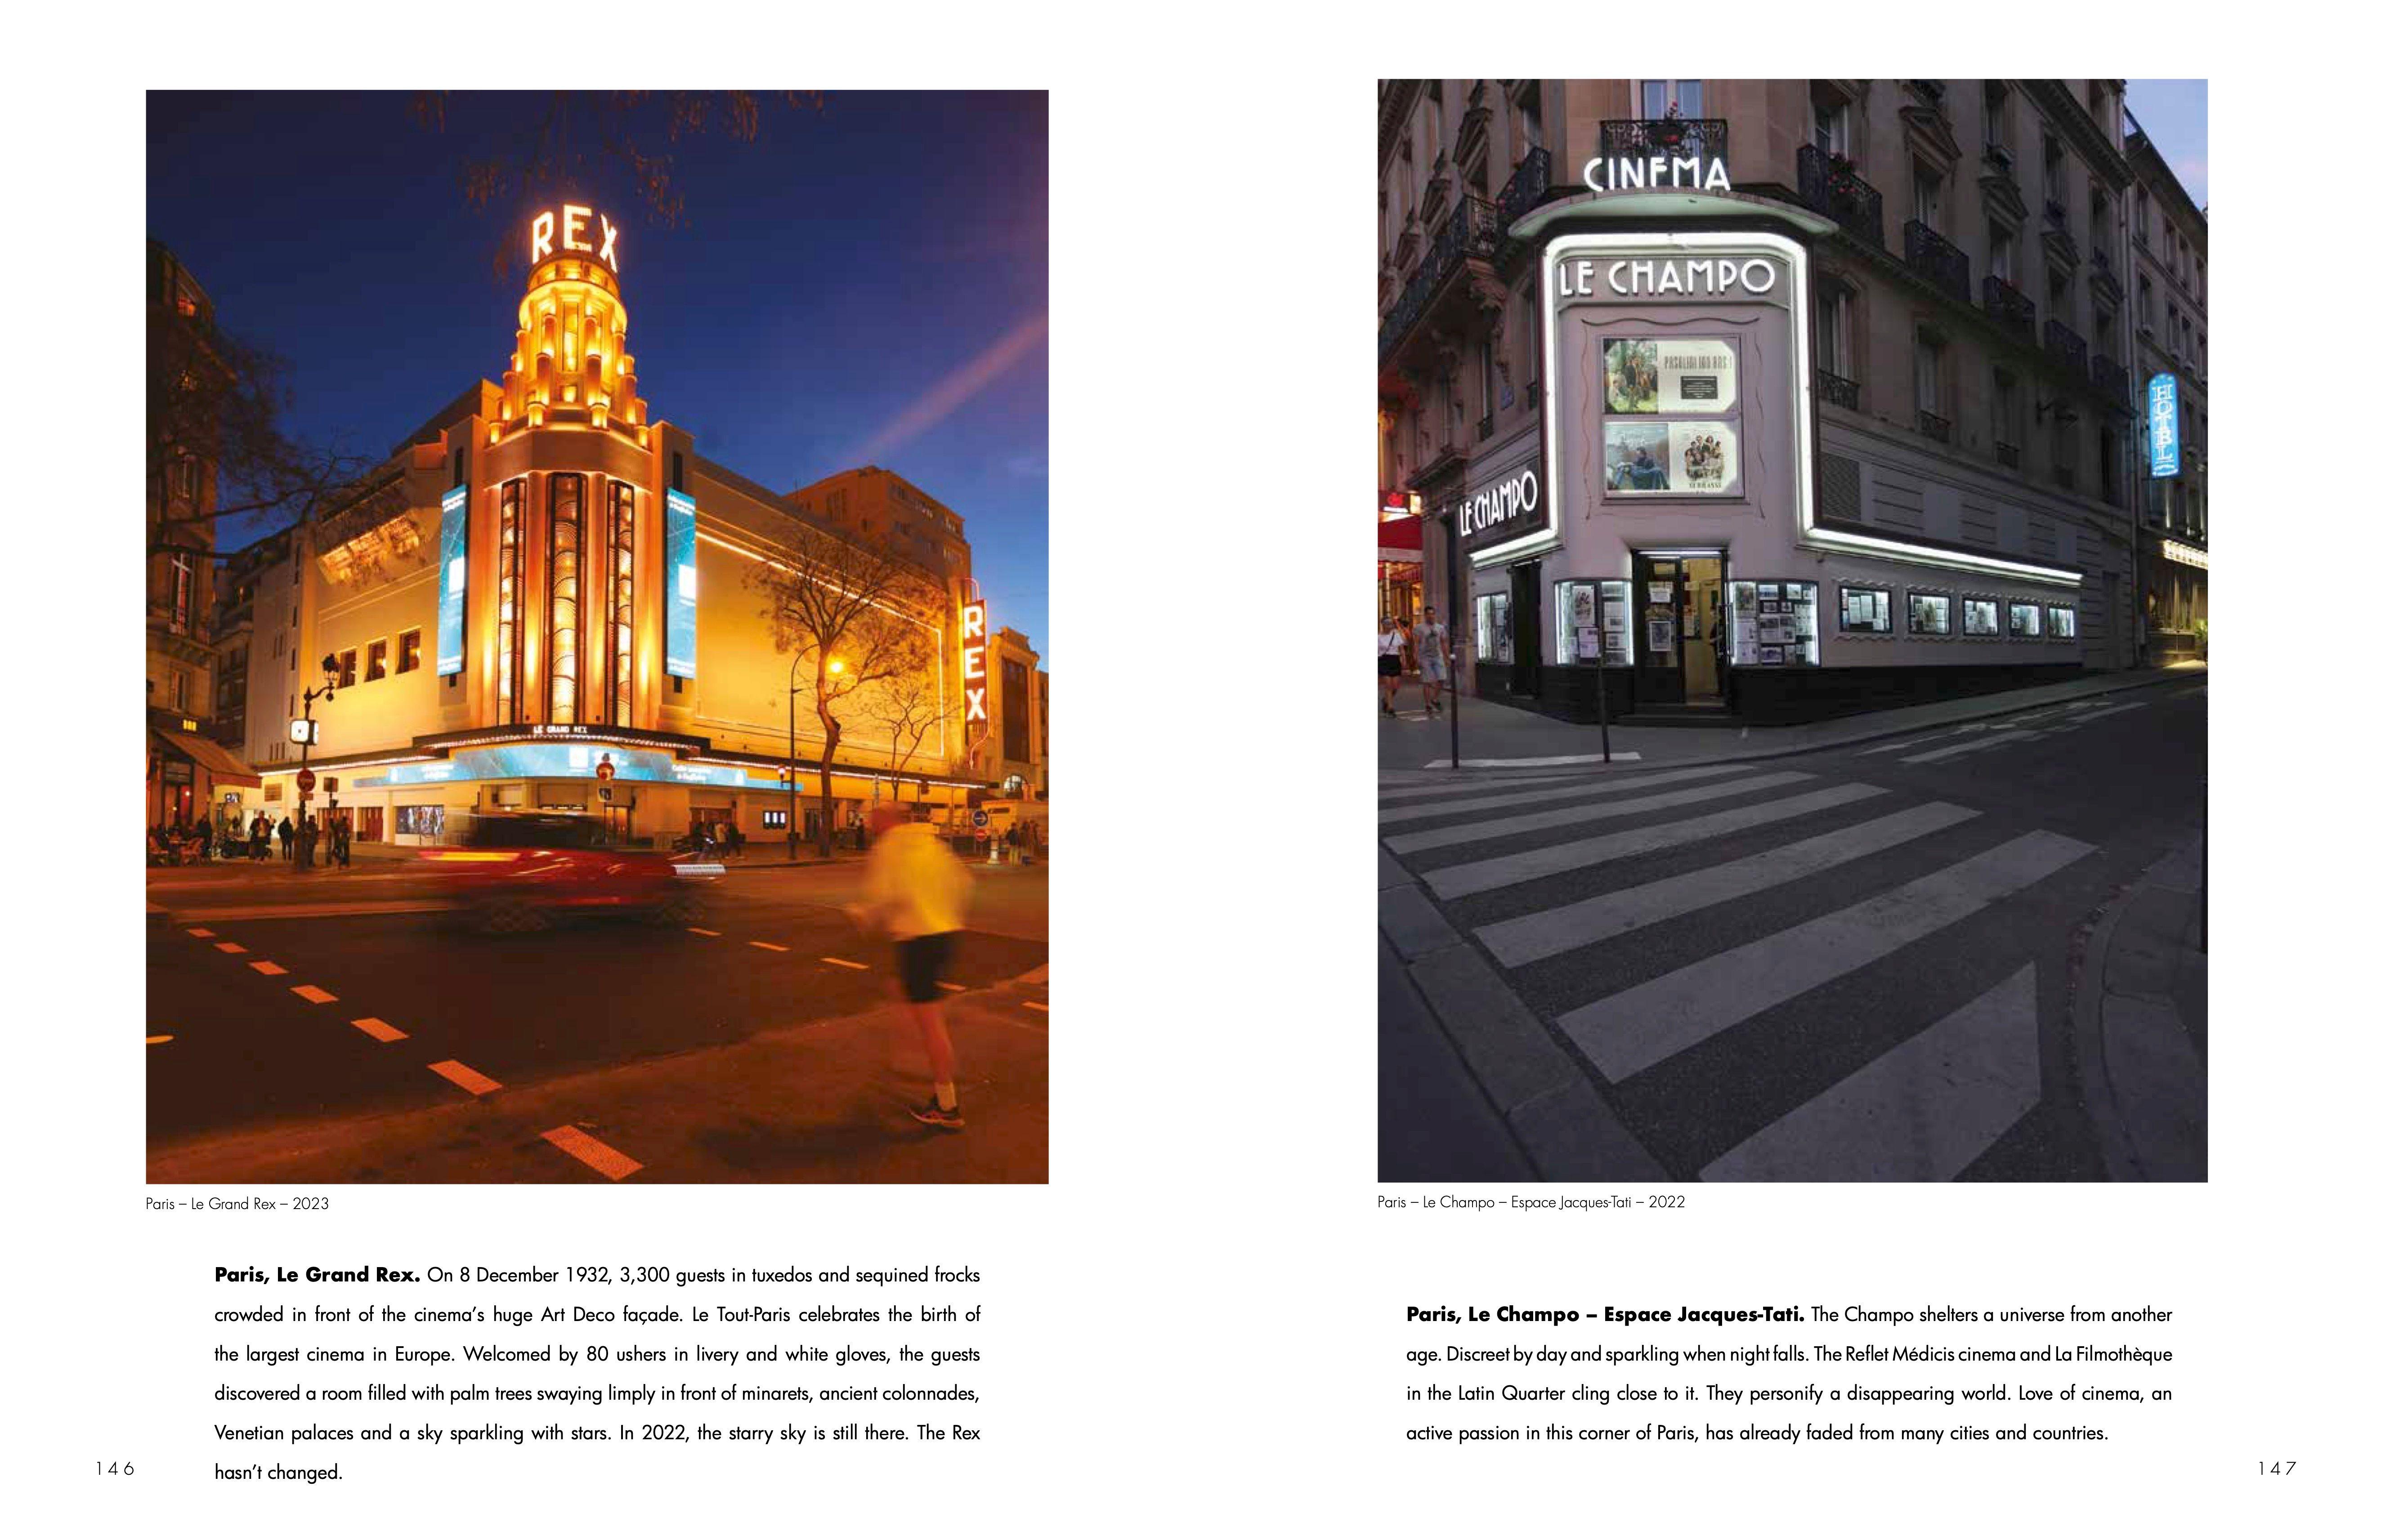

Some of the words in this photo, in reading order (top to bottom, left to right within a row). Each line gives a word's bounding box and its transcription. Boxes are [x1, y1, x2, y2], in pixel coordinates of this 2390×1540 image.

[532, 205, 618, 273] REX
[1560, 261, 1594, 297] LE
[1608, 259, 1776, 295] CHAMPO
[1460, 501, 1472, 536] LE
[1475, 470, 1538, 529] CHAMPO
[963, 606, 986, 721] REX
